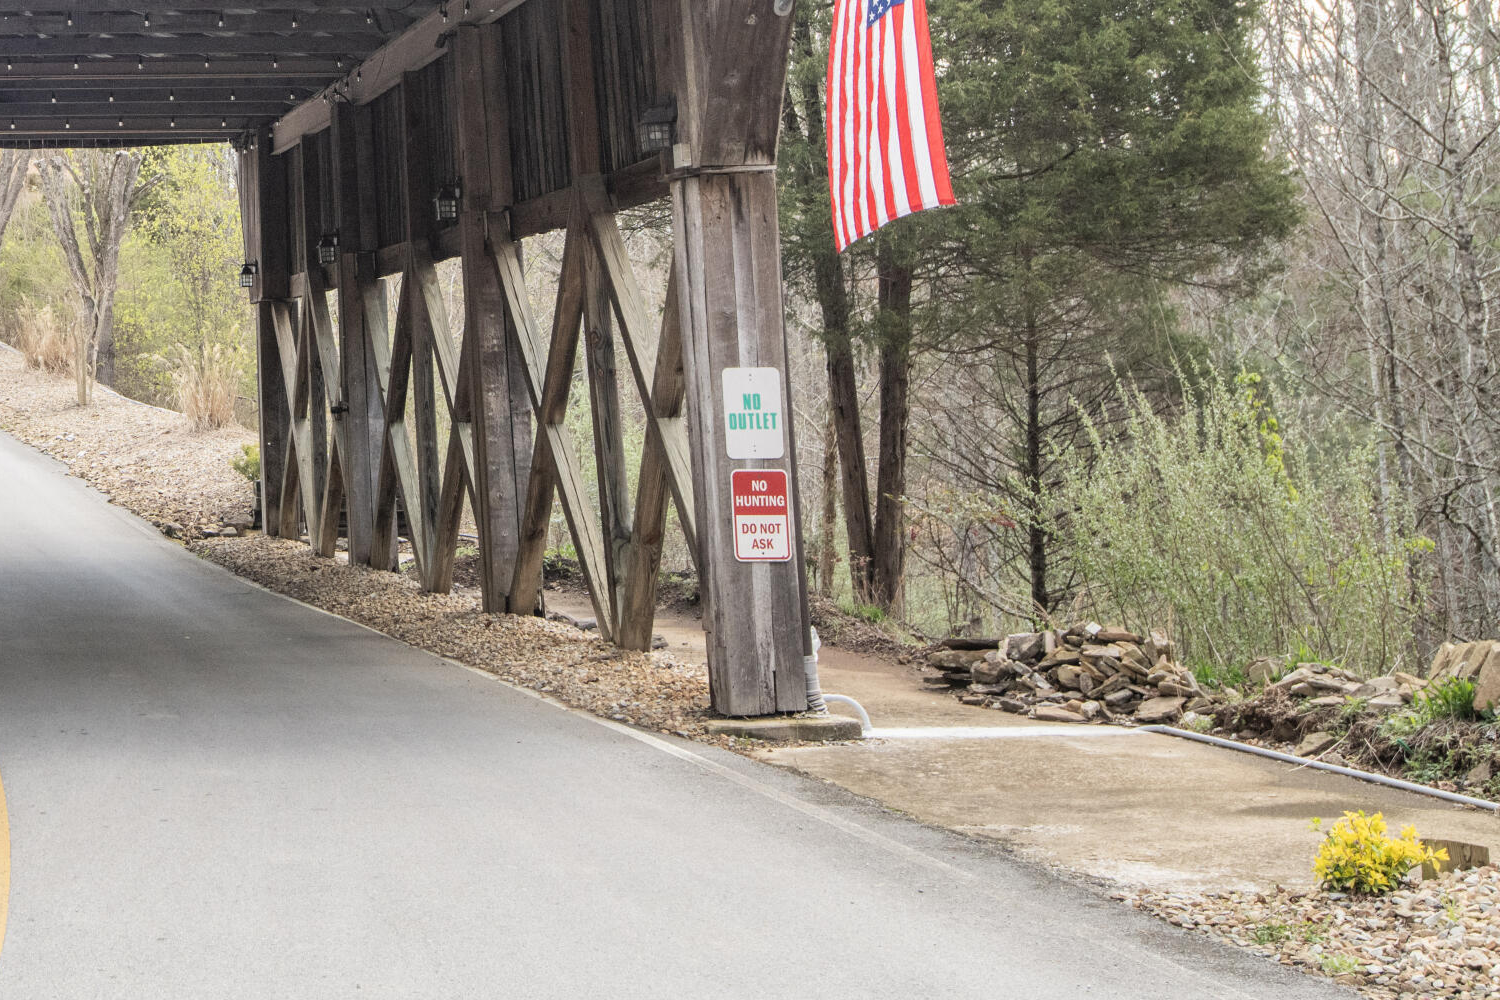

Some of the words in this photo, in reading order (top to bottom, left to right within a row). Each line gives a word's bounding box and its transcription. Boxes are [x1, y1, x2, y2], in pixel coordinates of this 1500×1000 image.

[742, 393, 761, 410] NO
[728, 412, 777, 430] OUTLET
[751, 480, 767, 492] NO
[735, 495, 785, 507] HUNTING
[741, 523, 757, 534] DO
[760, 523, 781, 534] NOT
[752, 539, 774, 549] ASK
